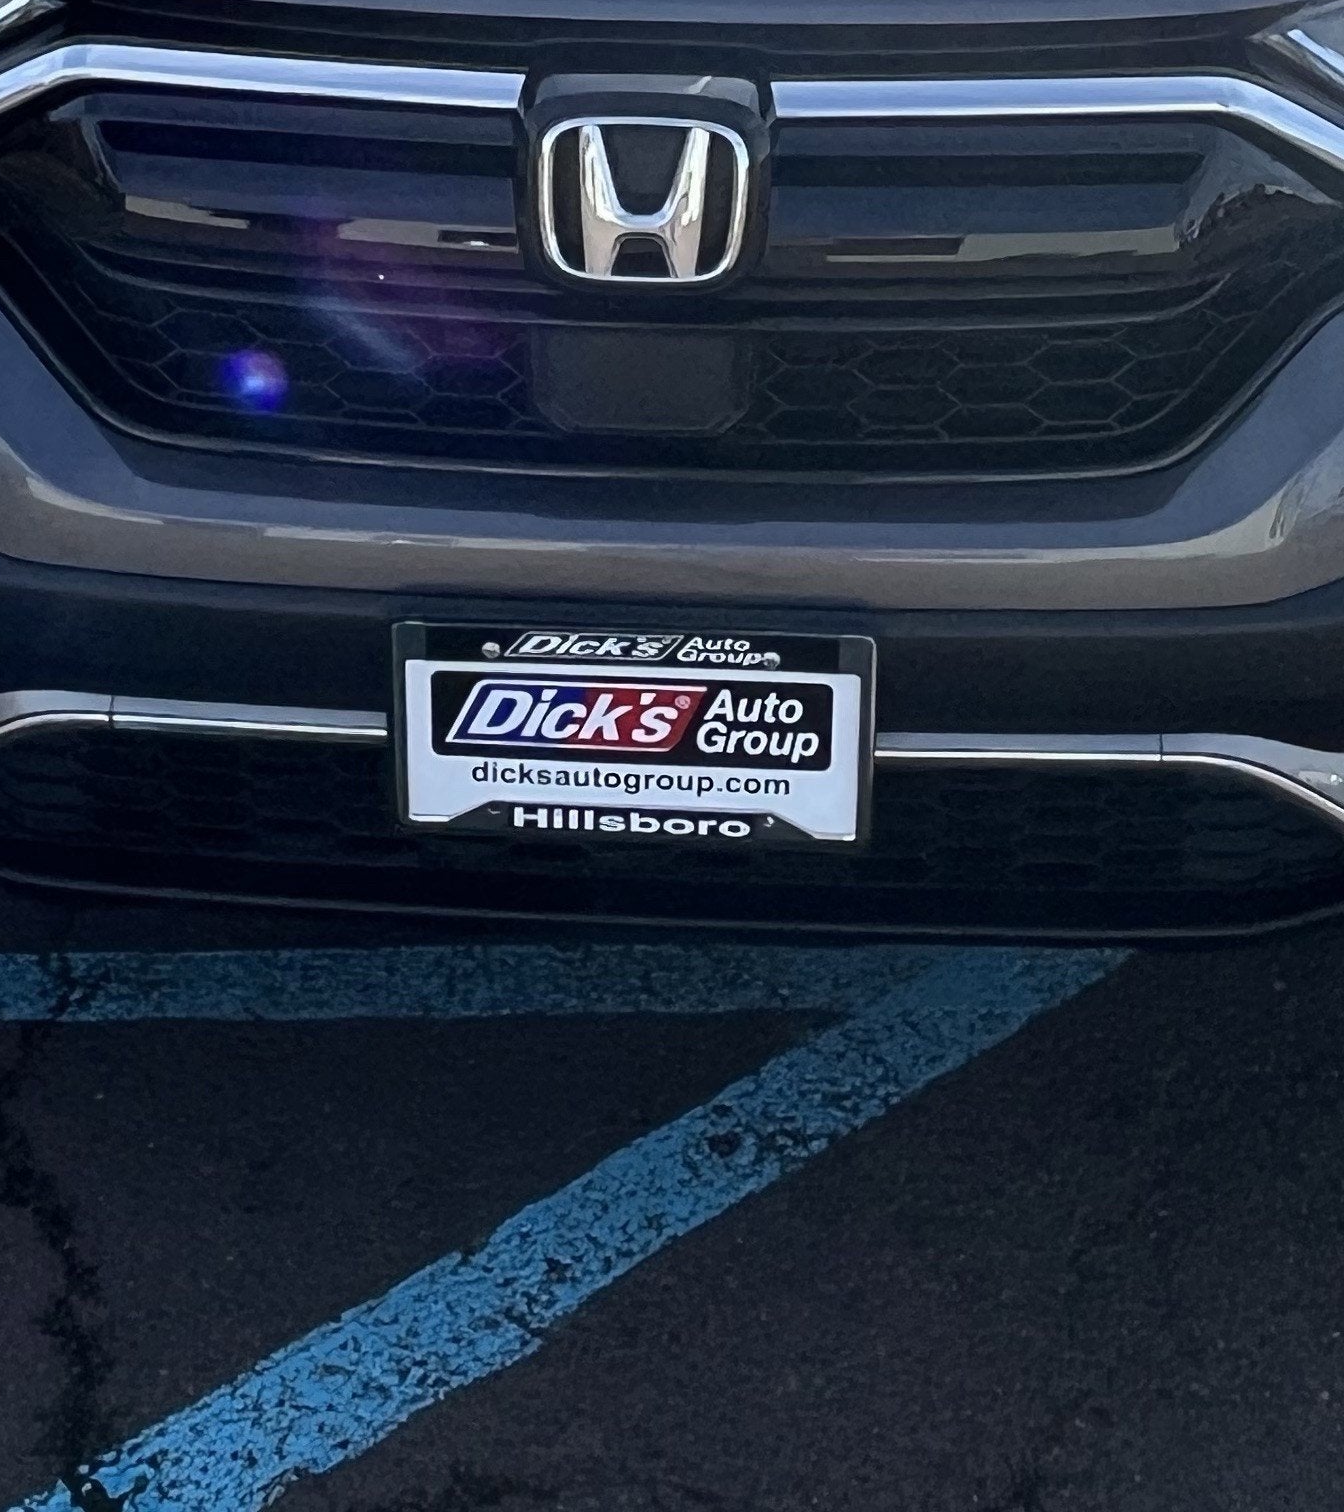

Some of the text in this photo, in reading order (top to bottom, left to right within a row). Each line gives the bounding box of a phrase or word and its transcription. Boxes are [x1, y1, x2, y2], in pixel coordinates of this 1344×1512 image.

[467, 687, 804, 743] Dick's Auto
[696, 721, 819, 763] Group
[471, 761, 791, 796] dicksautogroup.com
[513, 806, 751, 838] Hillsboro
